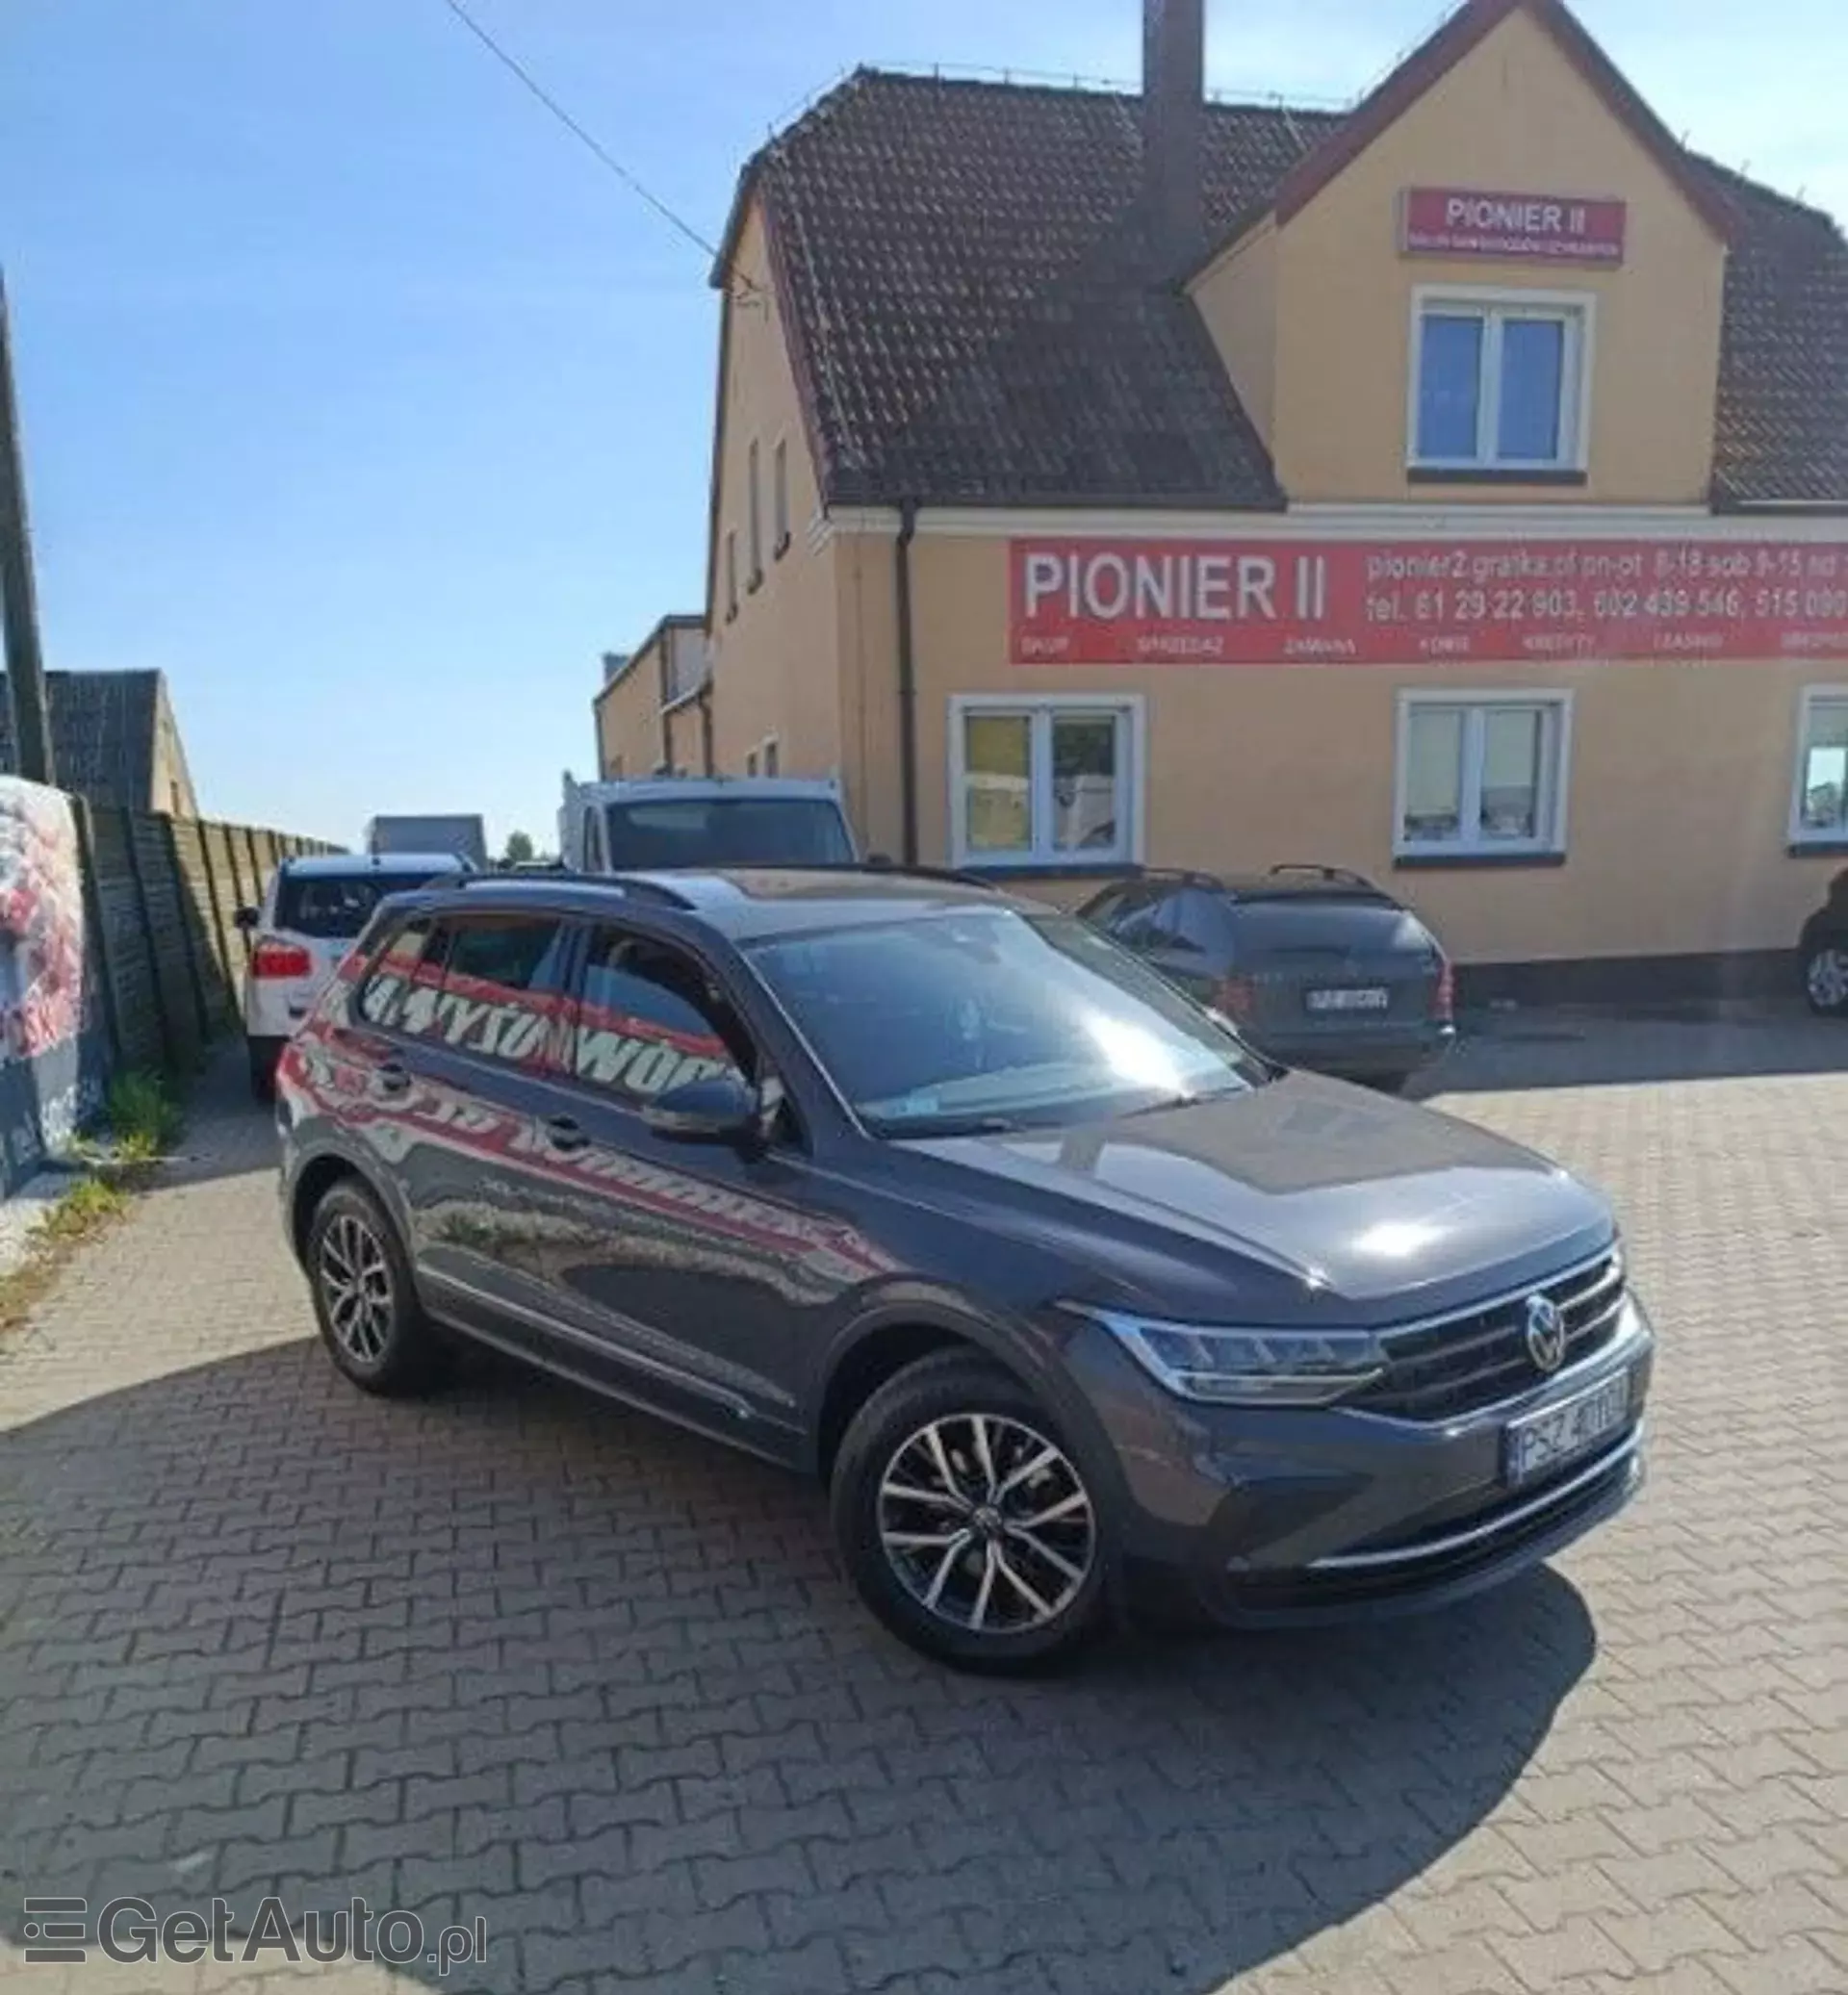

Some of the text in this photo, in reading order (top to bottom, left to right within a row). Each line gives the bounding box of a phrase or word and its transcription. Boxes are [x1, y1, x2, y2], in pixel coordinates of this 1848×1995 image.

[1446, 198, 1586, 234] PIONIER II
[1023, 552, 1326, 621] PIONIER II
[1494, 589, 1525, 620] 22
